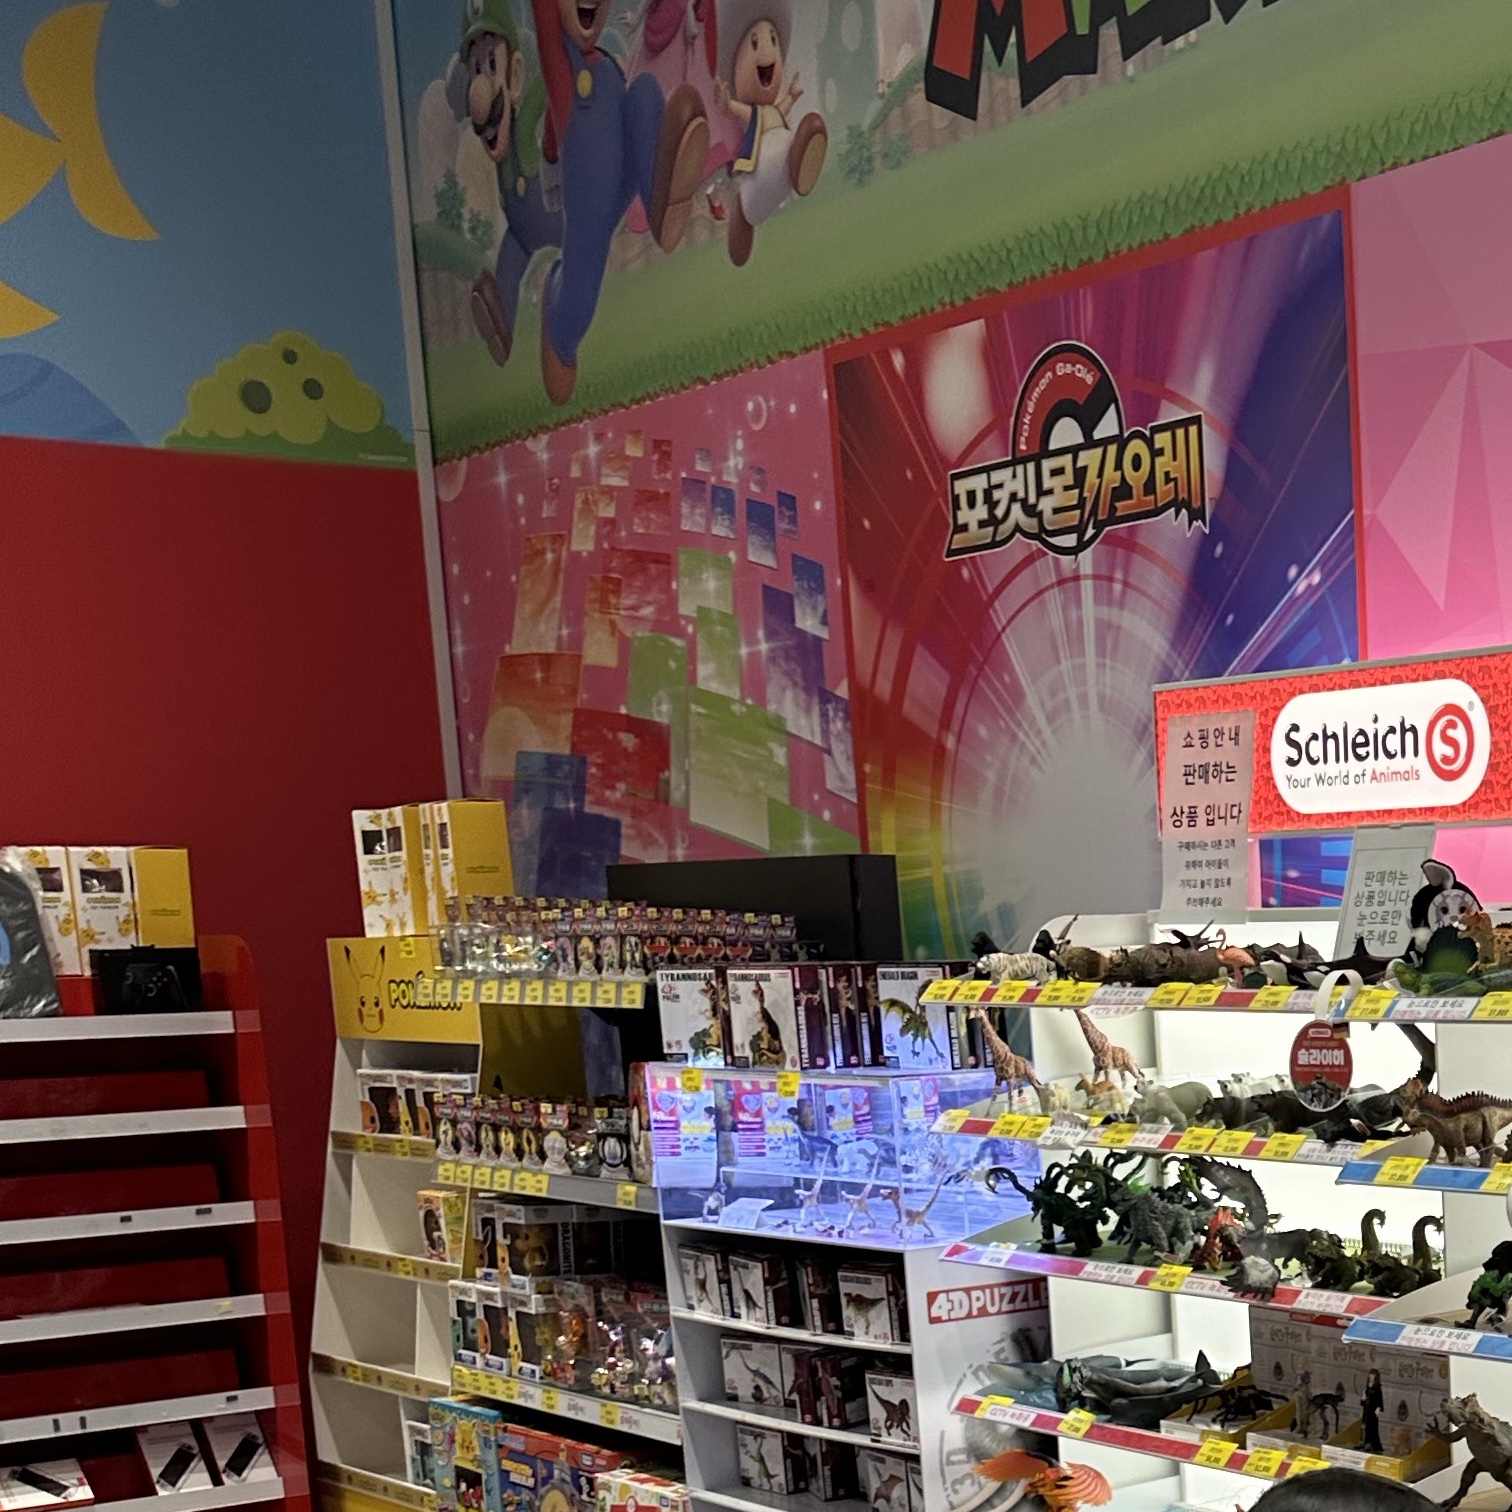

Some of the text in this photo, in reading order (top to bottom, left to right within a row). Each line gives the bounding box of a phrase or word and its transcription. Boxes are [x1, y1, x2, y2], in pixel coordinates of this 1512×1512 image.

[1284, 714, 1419, 767] Schleich
[1182, 762, 1238, 786] 판매하는
[1285, 765, 1420, 790] Your World of Animals
[1170, 802, 1243, 829] 상품 입니다
[1364, 870, 1409, 887] 판매하는
[1354, 890, 1411, 908] 상품입니다
[1356, 910, 1402, 927] 눈으로만
